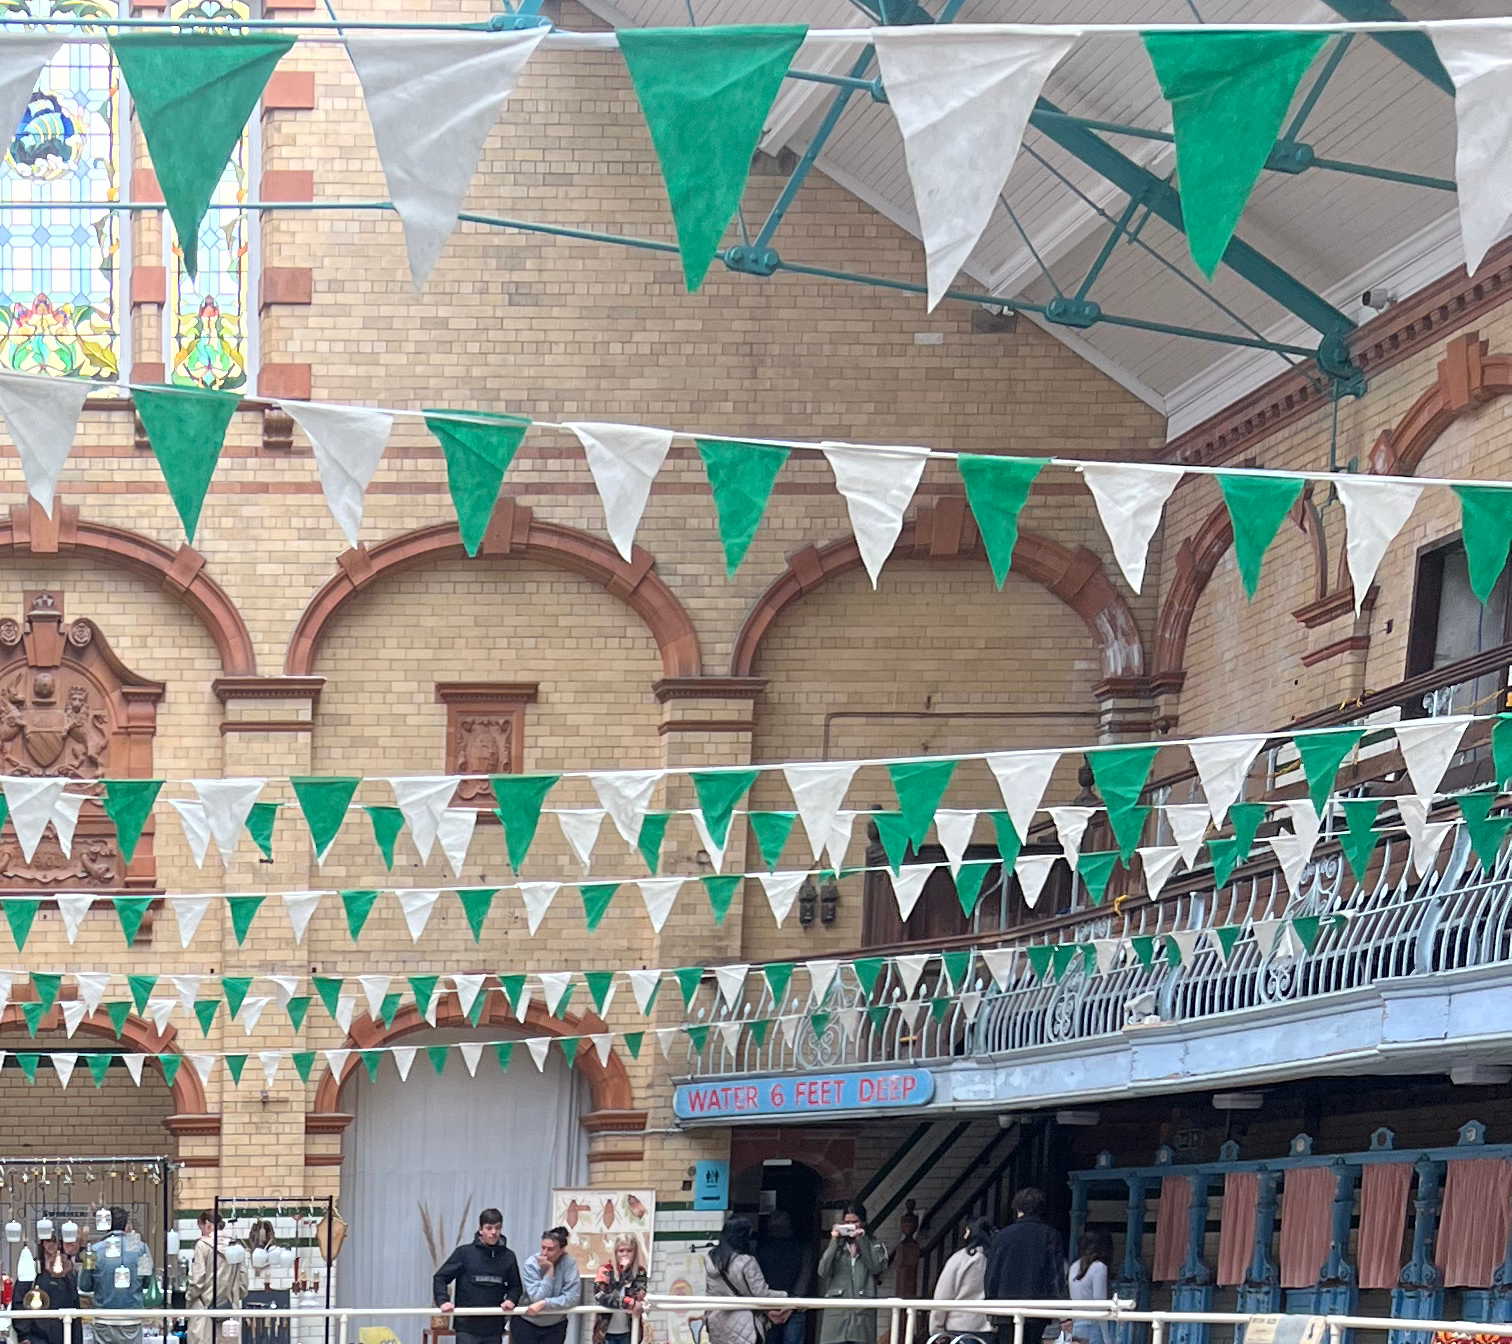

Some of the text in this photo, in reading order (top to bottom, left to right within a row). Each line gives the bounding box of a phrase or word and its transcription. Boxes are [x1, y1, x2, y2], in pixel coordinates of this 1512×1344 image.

[688, 1075, 917, 1113] WATER 6 FEET DEEP
